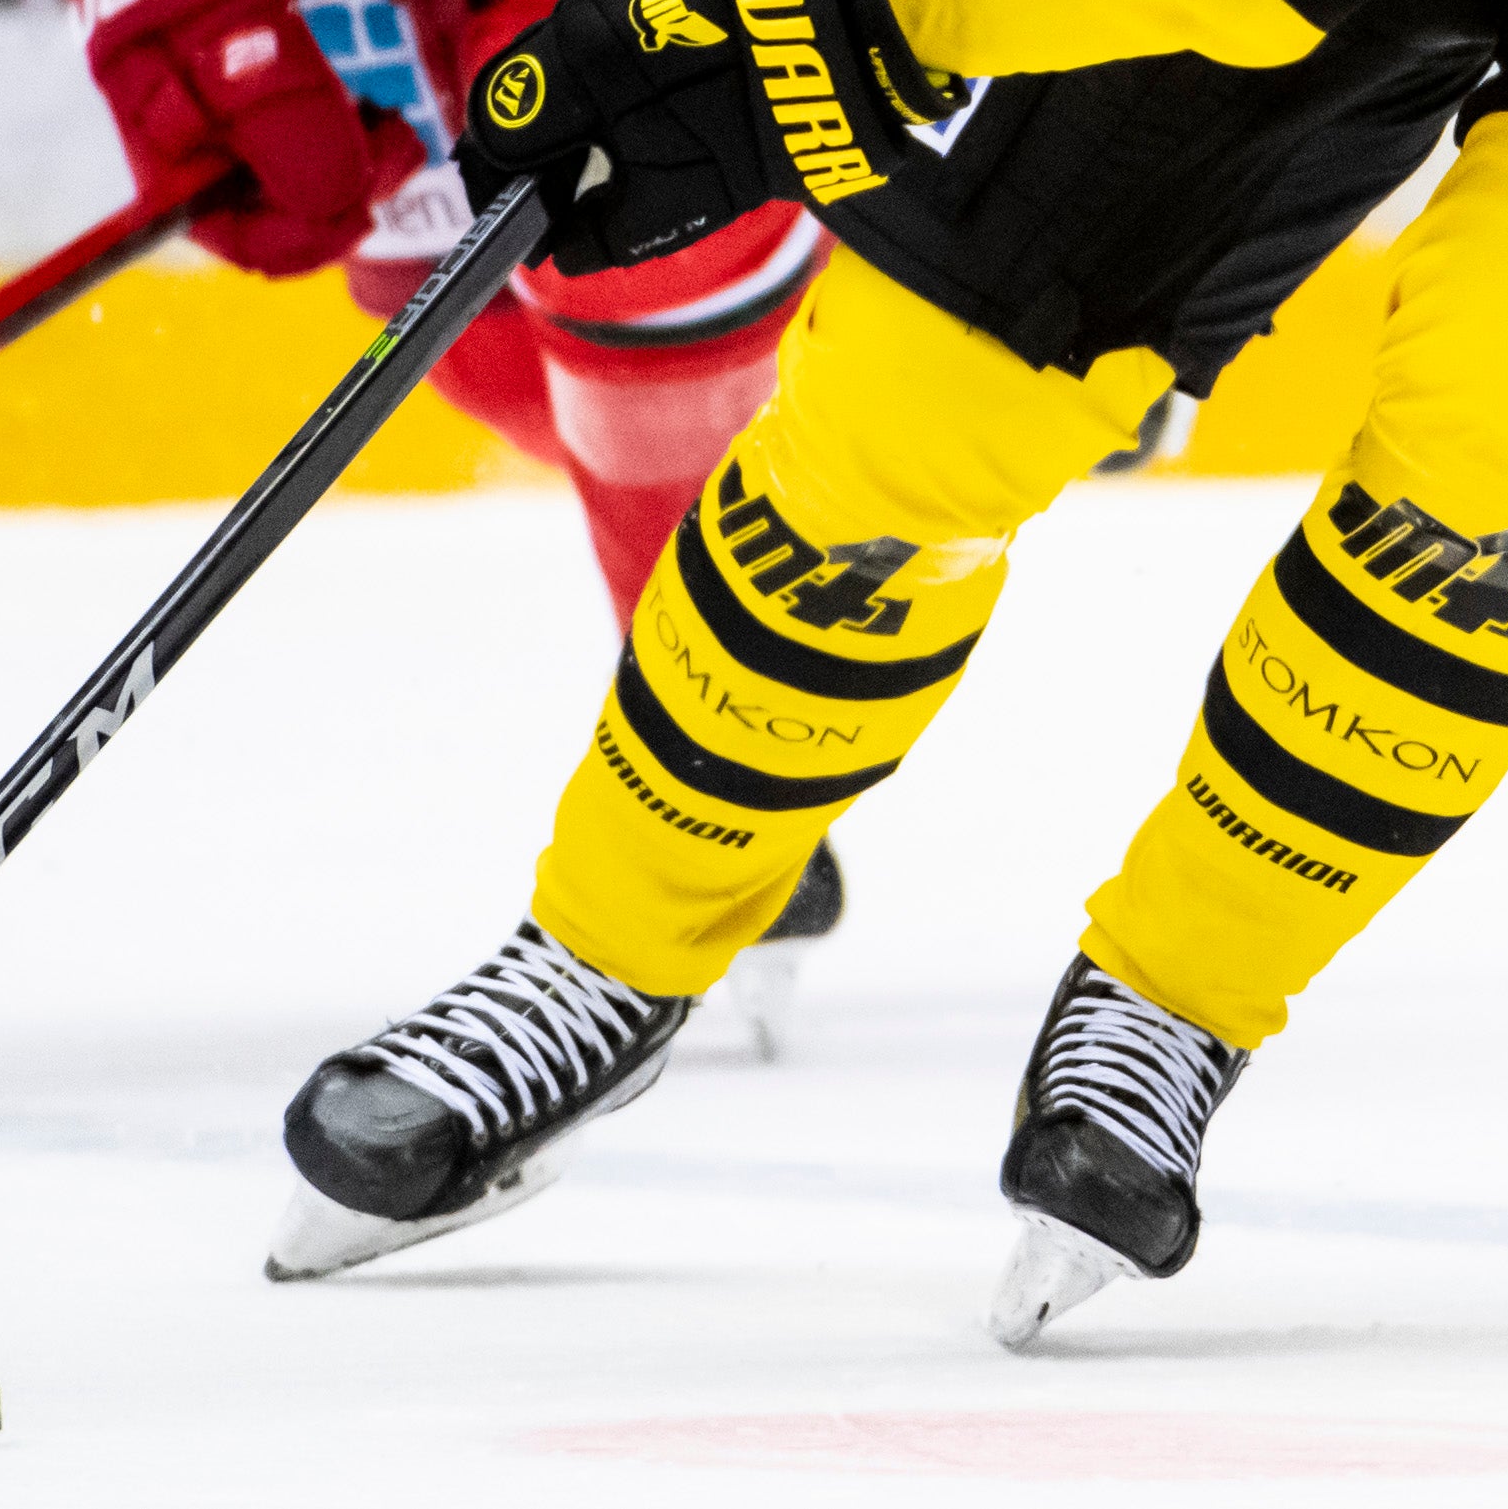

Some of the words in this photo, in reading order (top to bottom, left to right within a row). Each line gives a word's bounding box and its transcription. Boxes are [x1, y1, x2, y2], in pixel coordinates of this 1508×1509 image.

[644, 584, 863, 747] TOMKON
[1237, 617, 1483, 784] STOMKON
[596, 719, 756, 850] WARRIOR
[1185, 773, 1359, 895] WARRIOR
